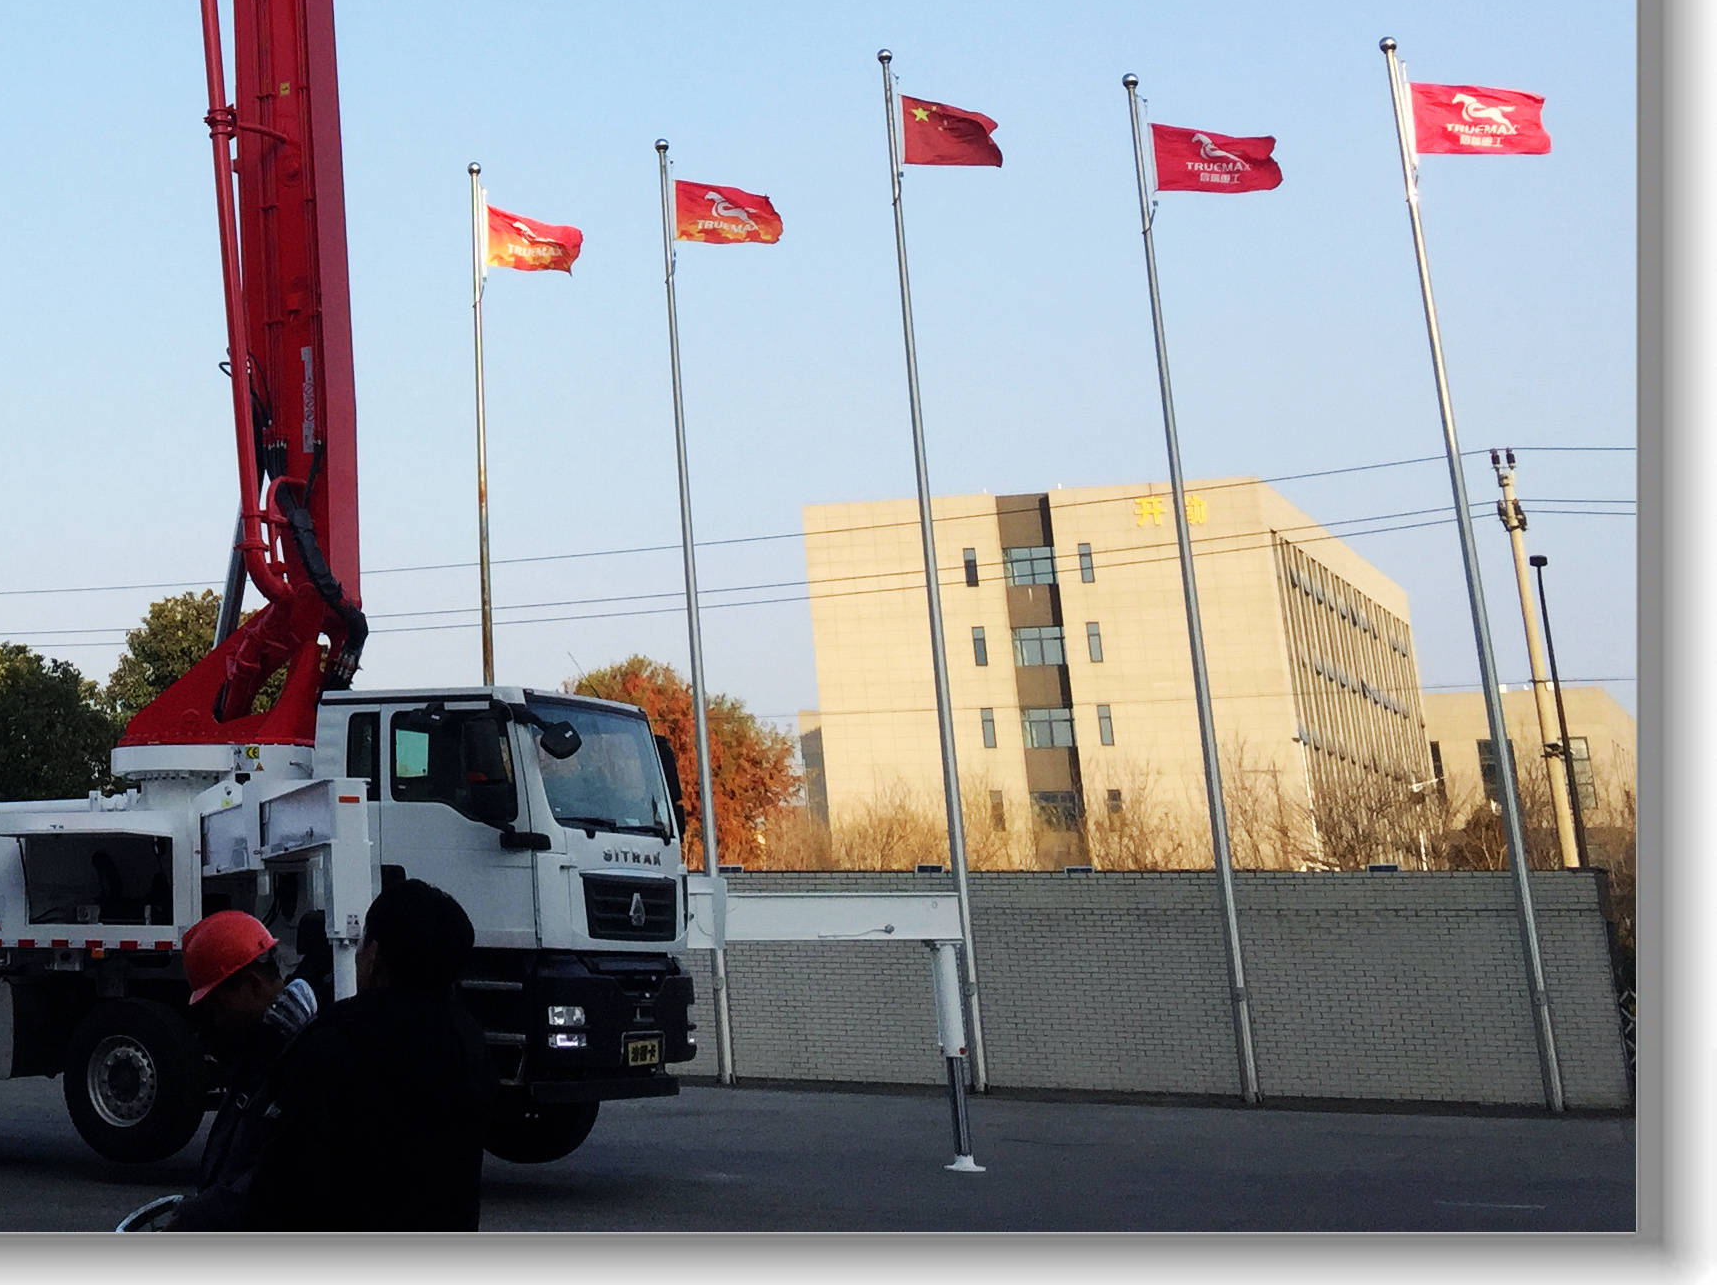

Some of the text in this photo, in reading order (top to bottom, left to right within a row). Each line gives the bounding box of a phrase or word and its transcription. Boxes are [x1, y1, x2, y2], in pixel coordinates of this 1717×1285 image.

[1446, 123, 1518, 135] TRUEMAX
[1185, 161, 1251, 172] TRUEMAX
[602, 849, 662, 866] SITRAK
